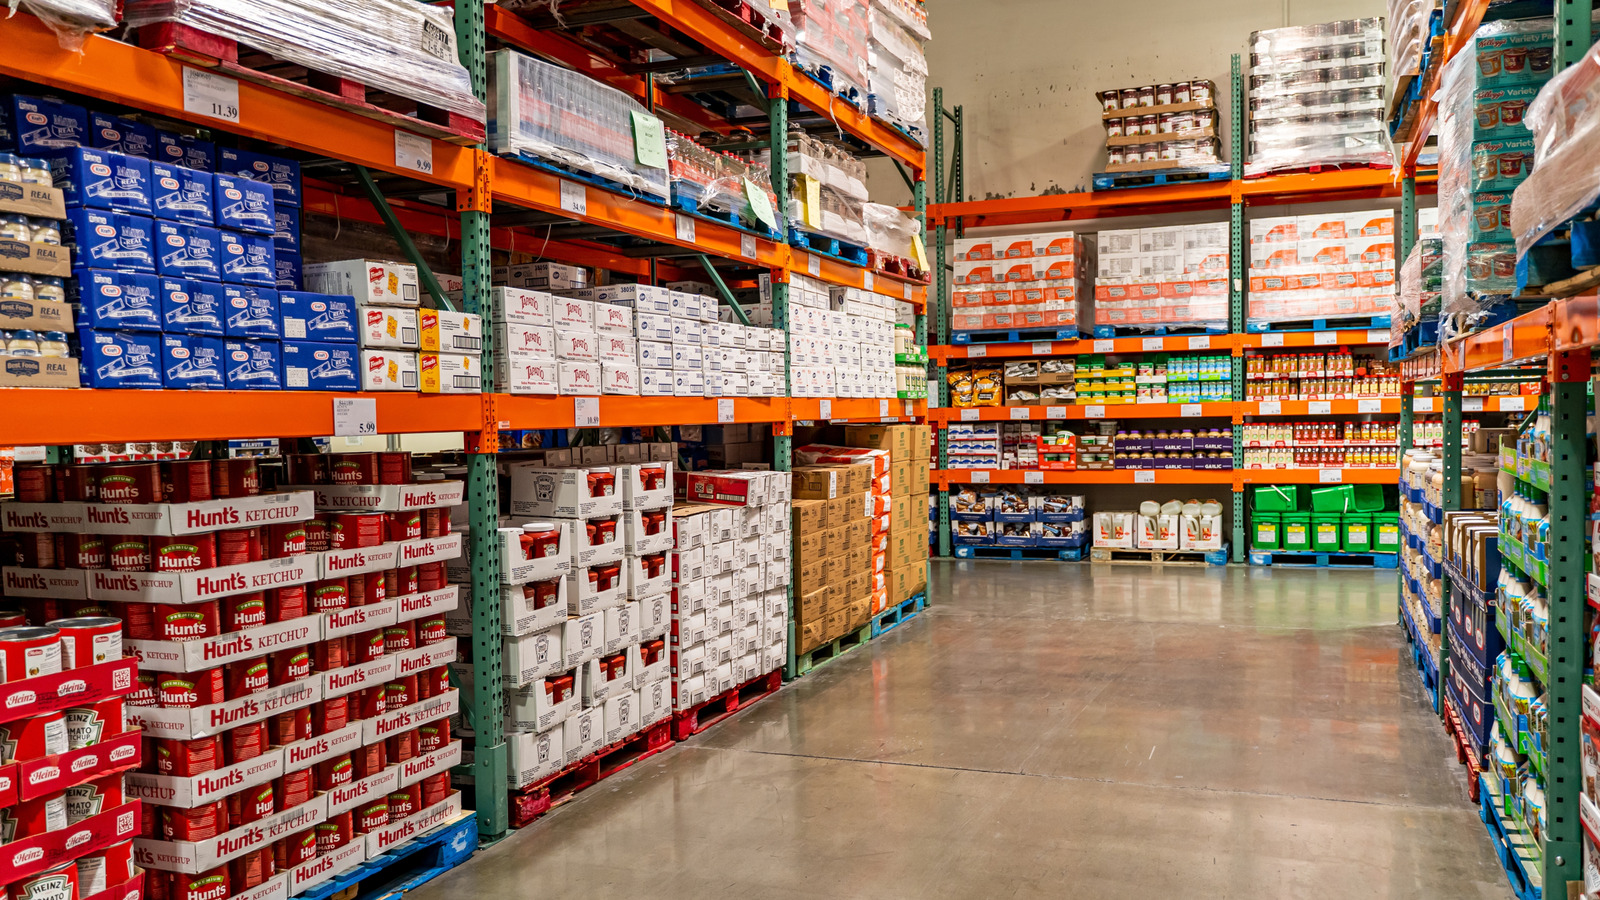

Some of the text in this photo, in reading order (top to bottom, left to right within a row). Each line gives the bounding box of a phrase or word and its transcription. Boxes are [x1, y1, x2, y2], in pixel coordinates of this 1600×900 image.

[1478, 34, 1539, 48] Kellogg's Variety
[1476, 87, 1537, 99] Kellogg's Variety
[212, 104, 238, 118] 11.39
[1506, 139, 1535, 148] Variety
[416, 160, 431, 171] 9.99
[31, 190, 52, 200] REAL
[573, 202, 586, 212] 34.99
[37, 249, 56, 258] REAL
[41, 307, 61, 315] REAL
[360, 423, 375, 433] 5.99
[332, 496, 381, 506] KETCHUP
[405, 492, 435, 507] Hunt's
[7, 511, 48, 528] Hunt's
[88, 506, 128, 524] Hunt's
[187, 506, 299, 528] Hunt's KETCHUP
[404, 542, 457, 559] Hunt's KETCHUP
[329, 552, 392, 571] Hunt's KETCHUP
[7, 572, 79, 590] Hunt's KETCHUP
[95, 573, 173, 591] Hunt's KETCHUP
[197, 568, 303, 596] Hunt's KETCHUP
[401, 592, 454, 612] Hunt's KETCHUP
[330, 607, 392, 629] Hunt's KETCHUP
[204, 627, 308, 660] Hunt's KETCHUP
[147, 652, 178, 660] KETCHUP
[401, 649, 454, 672] Hunt's KETCHUP
[330, 664, 391, 689] Hunt's KETCHUP
[60, 682, 84, 694] Heinz
[8, 692, 35, 705] Heinz
[210, 688, 312, 727] Hunt's KETCHUP
[151, 721, 184, 730] KETCHUP
[376, 702, 451, 735] Hunt's KETCHUP
[113, 747, 134, 759] Heinz
[290, 732, 357, 763] Hunt's KETCHUP
[75, 757, 96, 769] Heinz
[404, 748, 457, 777] Hunt's KETCHUP
[33, 769, 58, 782] Heinz
[198, 759, 277, 796] Hunt's KETCHUP
[333, 774, 394, 805] Hunt's KETCHUP
[217, 809, 318, 858] Hunt's KETCHUP
[378, 805, 454, 848] Hunt's KETCHUP
[67, 834, 90, 846] Heinz
[15, 850, 42, 862] Heinz
[157, 854, 190, 865] KETCHUP
[296, 845, 360, 884] Hunt's KETCHUP
[33, 881, 61, 894] HEINZ
[252, 882, 282, 900] KETCHUP
